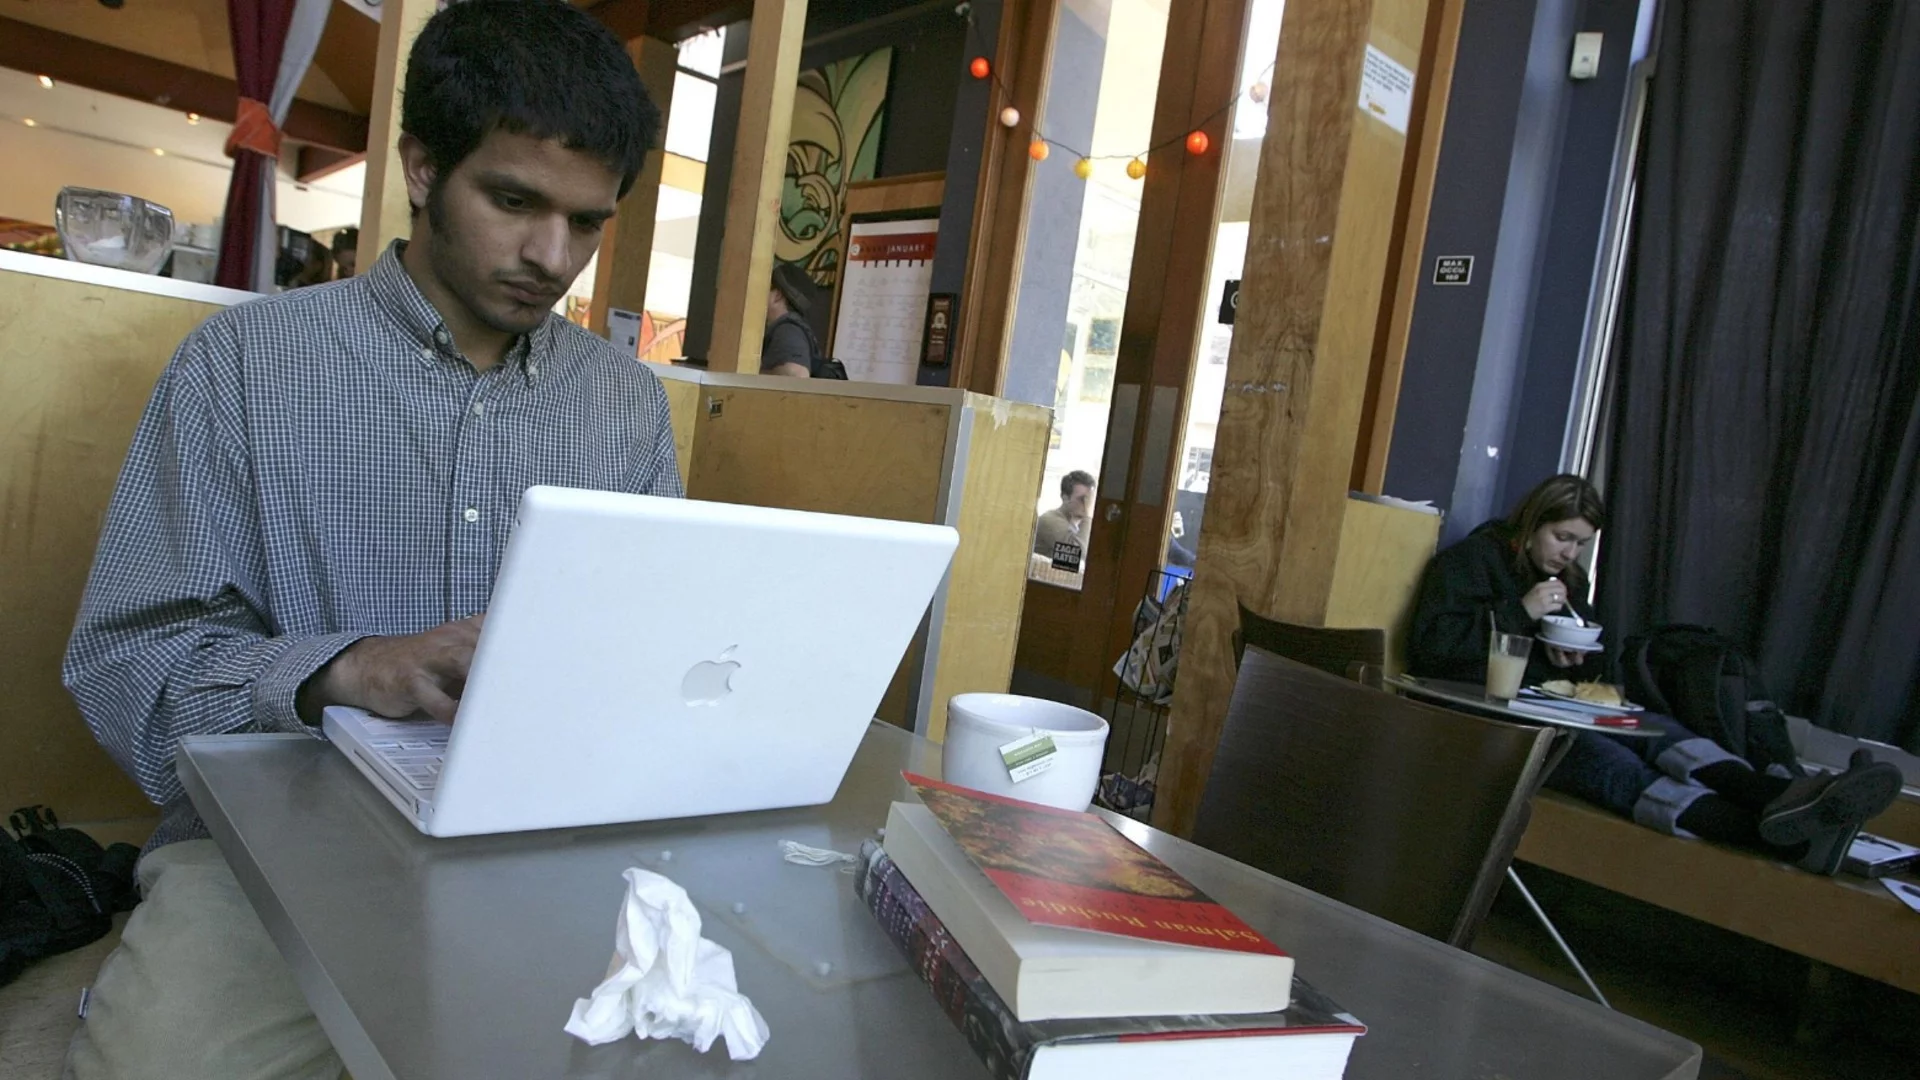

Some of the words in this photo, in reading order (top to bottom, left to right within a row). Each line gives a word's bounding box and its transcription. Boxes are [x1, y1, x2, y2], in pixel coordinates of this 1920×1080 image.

[886, 243, 926, 255] JANUARY
[1053, 551, 1080, 564] RATED
[1022, 897, 1146, 929] Rushdie
[1154, 918, 1261, 944] Salman
